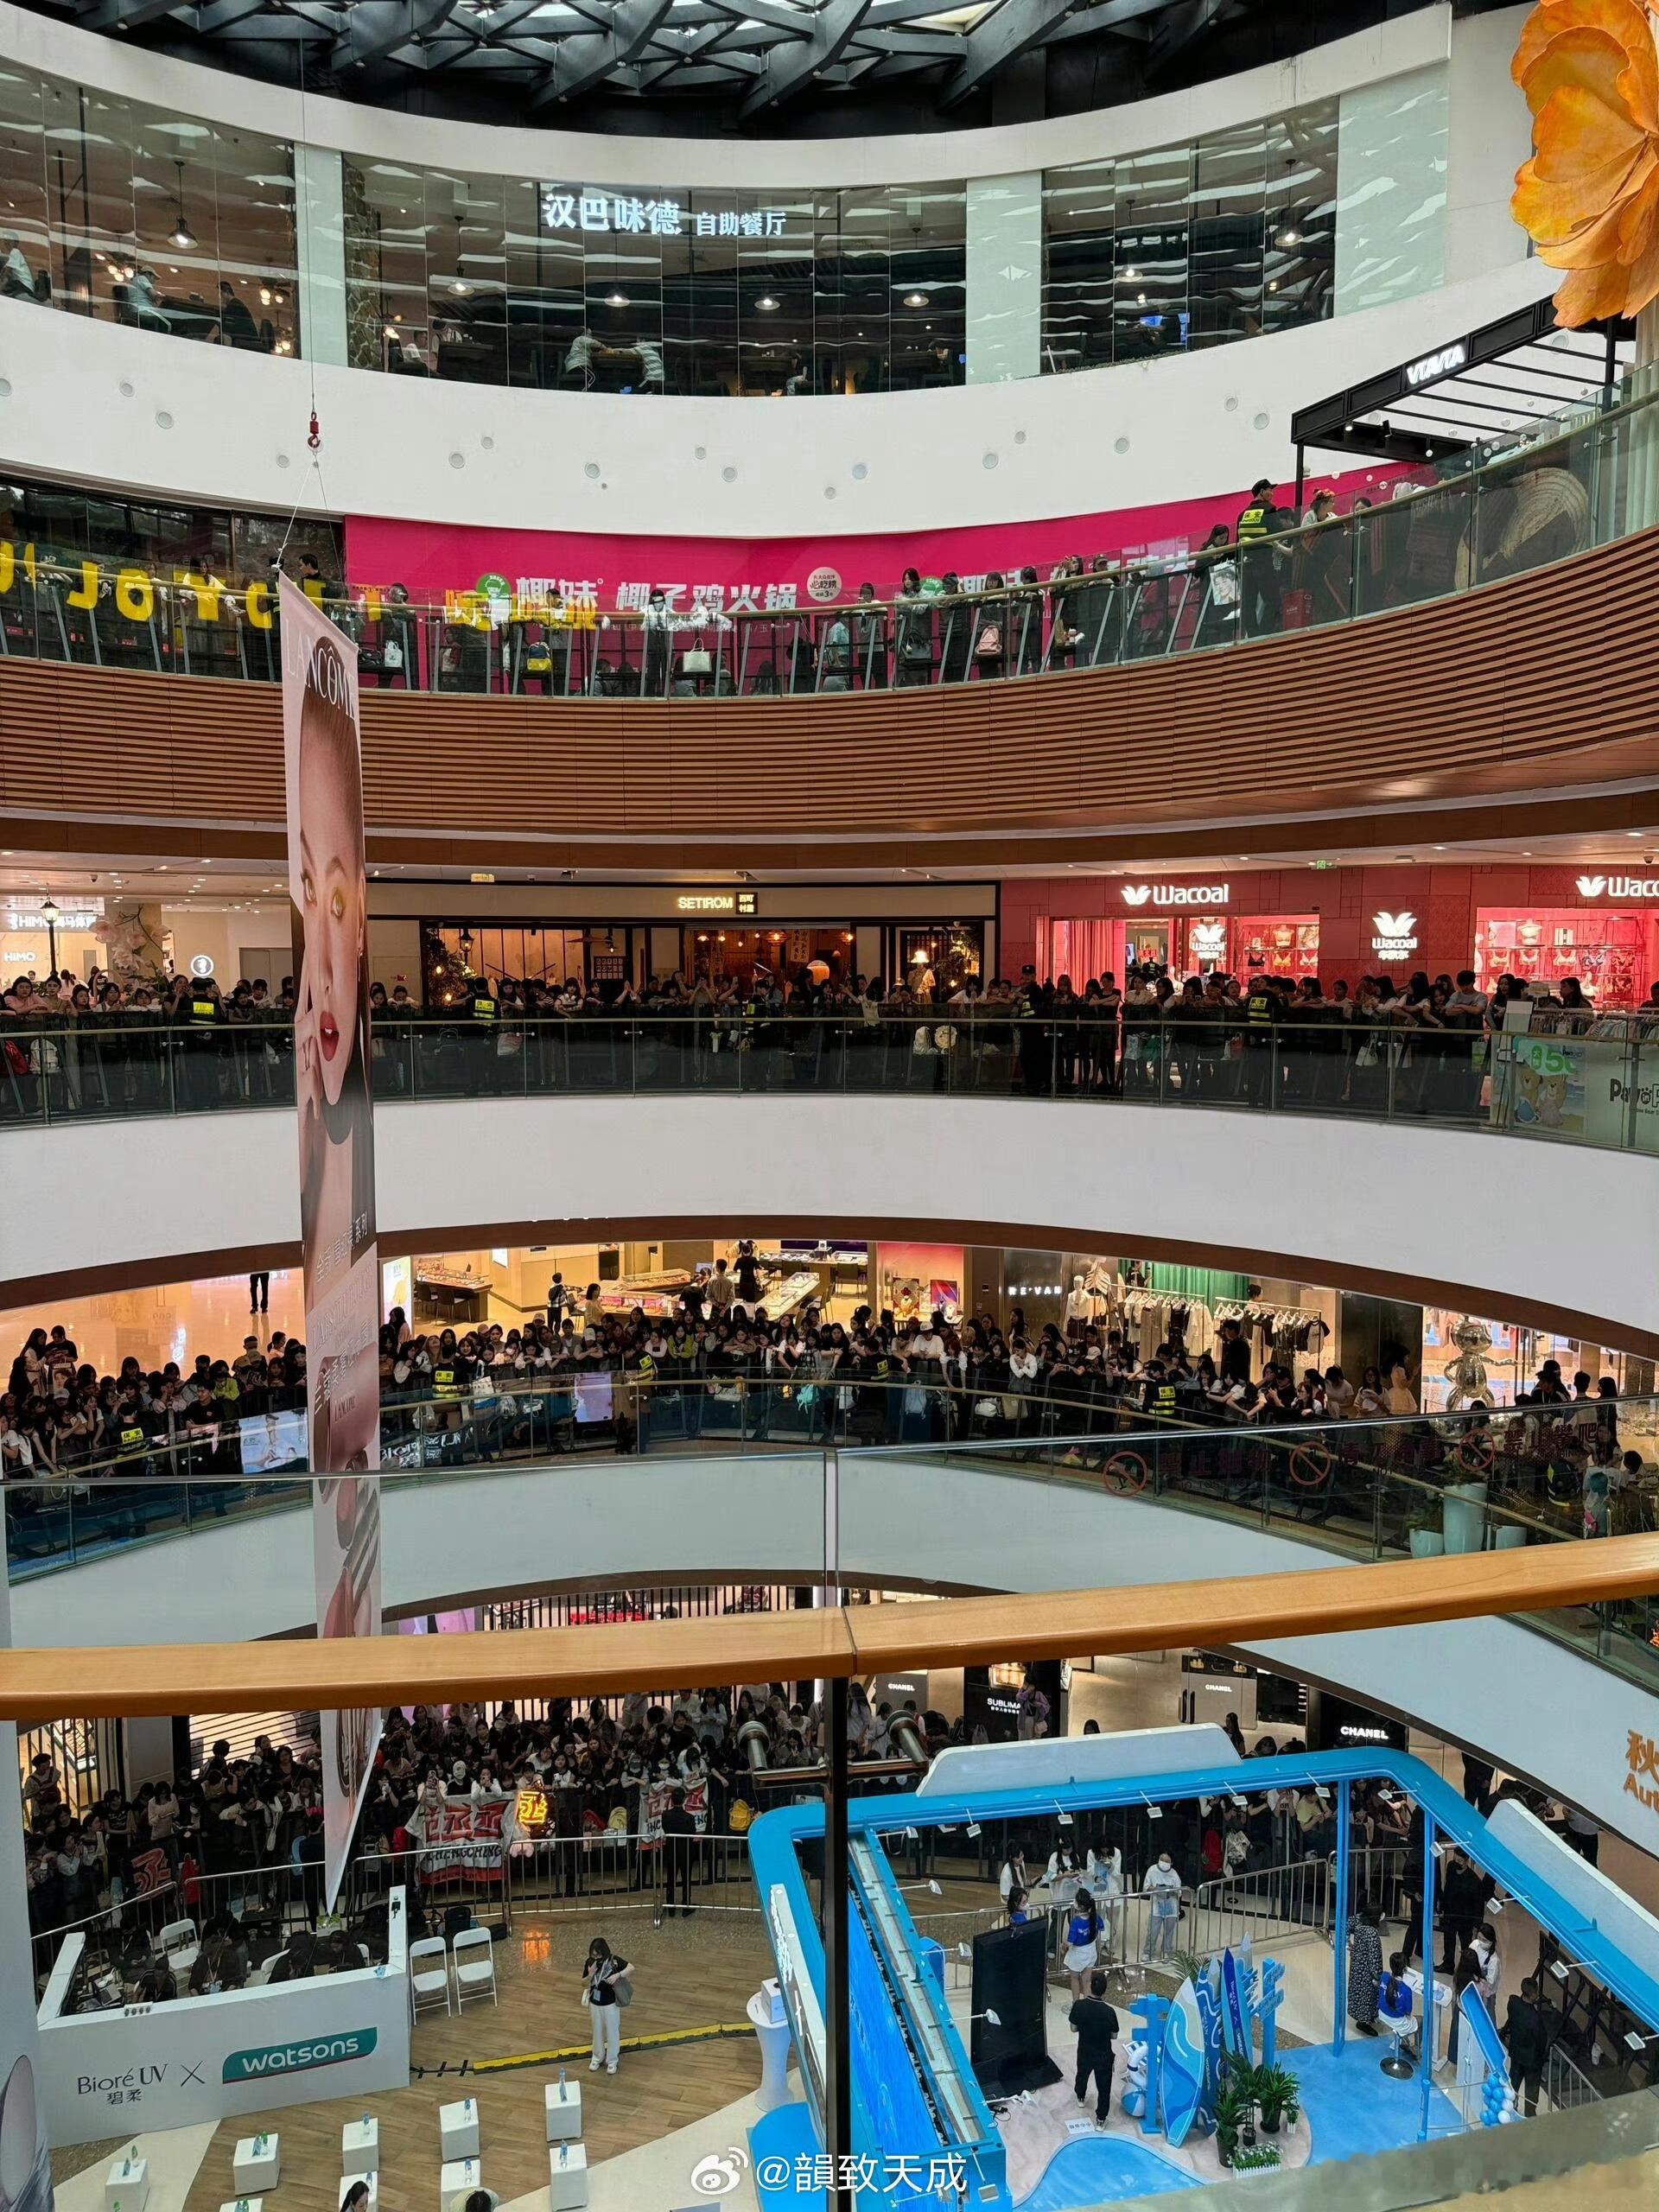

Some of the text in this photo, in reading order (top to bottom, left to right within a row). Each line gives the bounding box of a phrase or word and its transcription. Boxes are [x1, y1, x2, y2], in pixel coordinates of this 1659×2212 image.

[545, 194, 787, 236] 汉巴味德 自助餐厅
[285, 618, 355, 721] LANCÔME
[1153, 884, 1229, 905] Wacoal
[677, 897, 733, 909] SETIROM
[1192, 942, 1224, 951] Wacoal
[1371, 937, 1417, 949] Wacoal
[3, 951, 36, 962] HIMO
[887, 1682, 915, 1692] CHANEL
[1205, 1683, 1233, 1693] CHANEL
[1340, 1726, 1389, 1739] CHANEL
[77, 2068, 135, 2095] Bioré
[139, 2063, 168, 2084] UV
[241, 2036, 360, 2073] watsons
[105, 2088, 143, 2105] 碧柔
